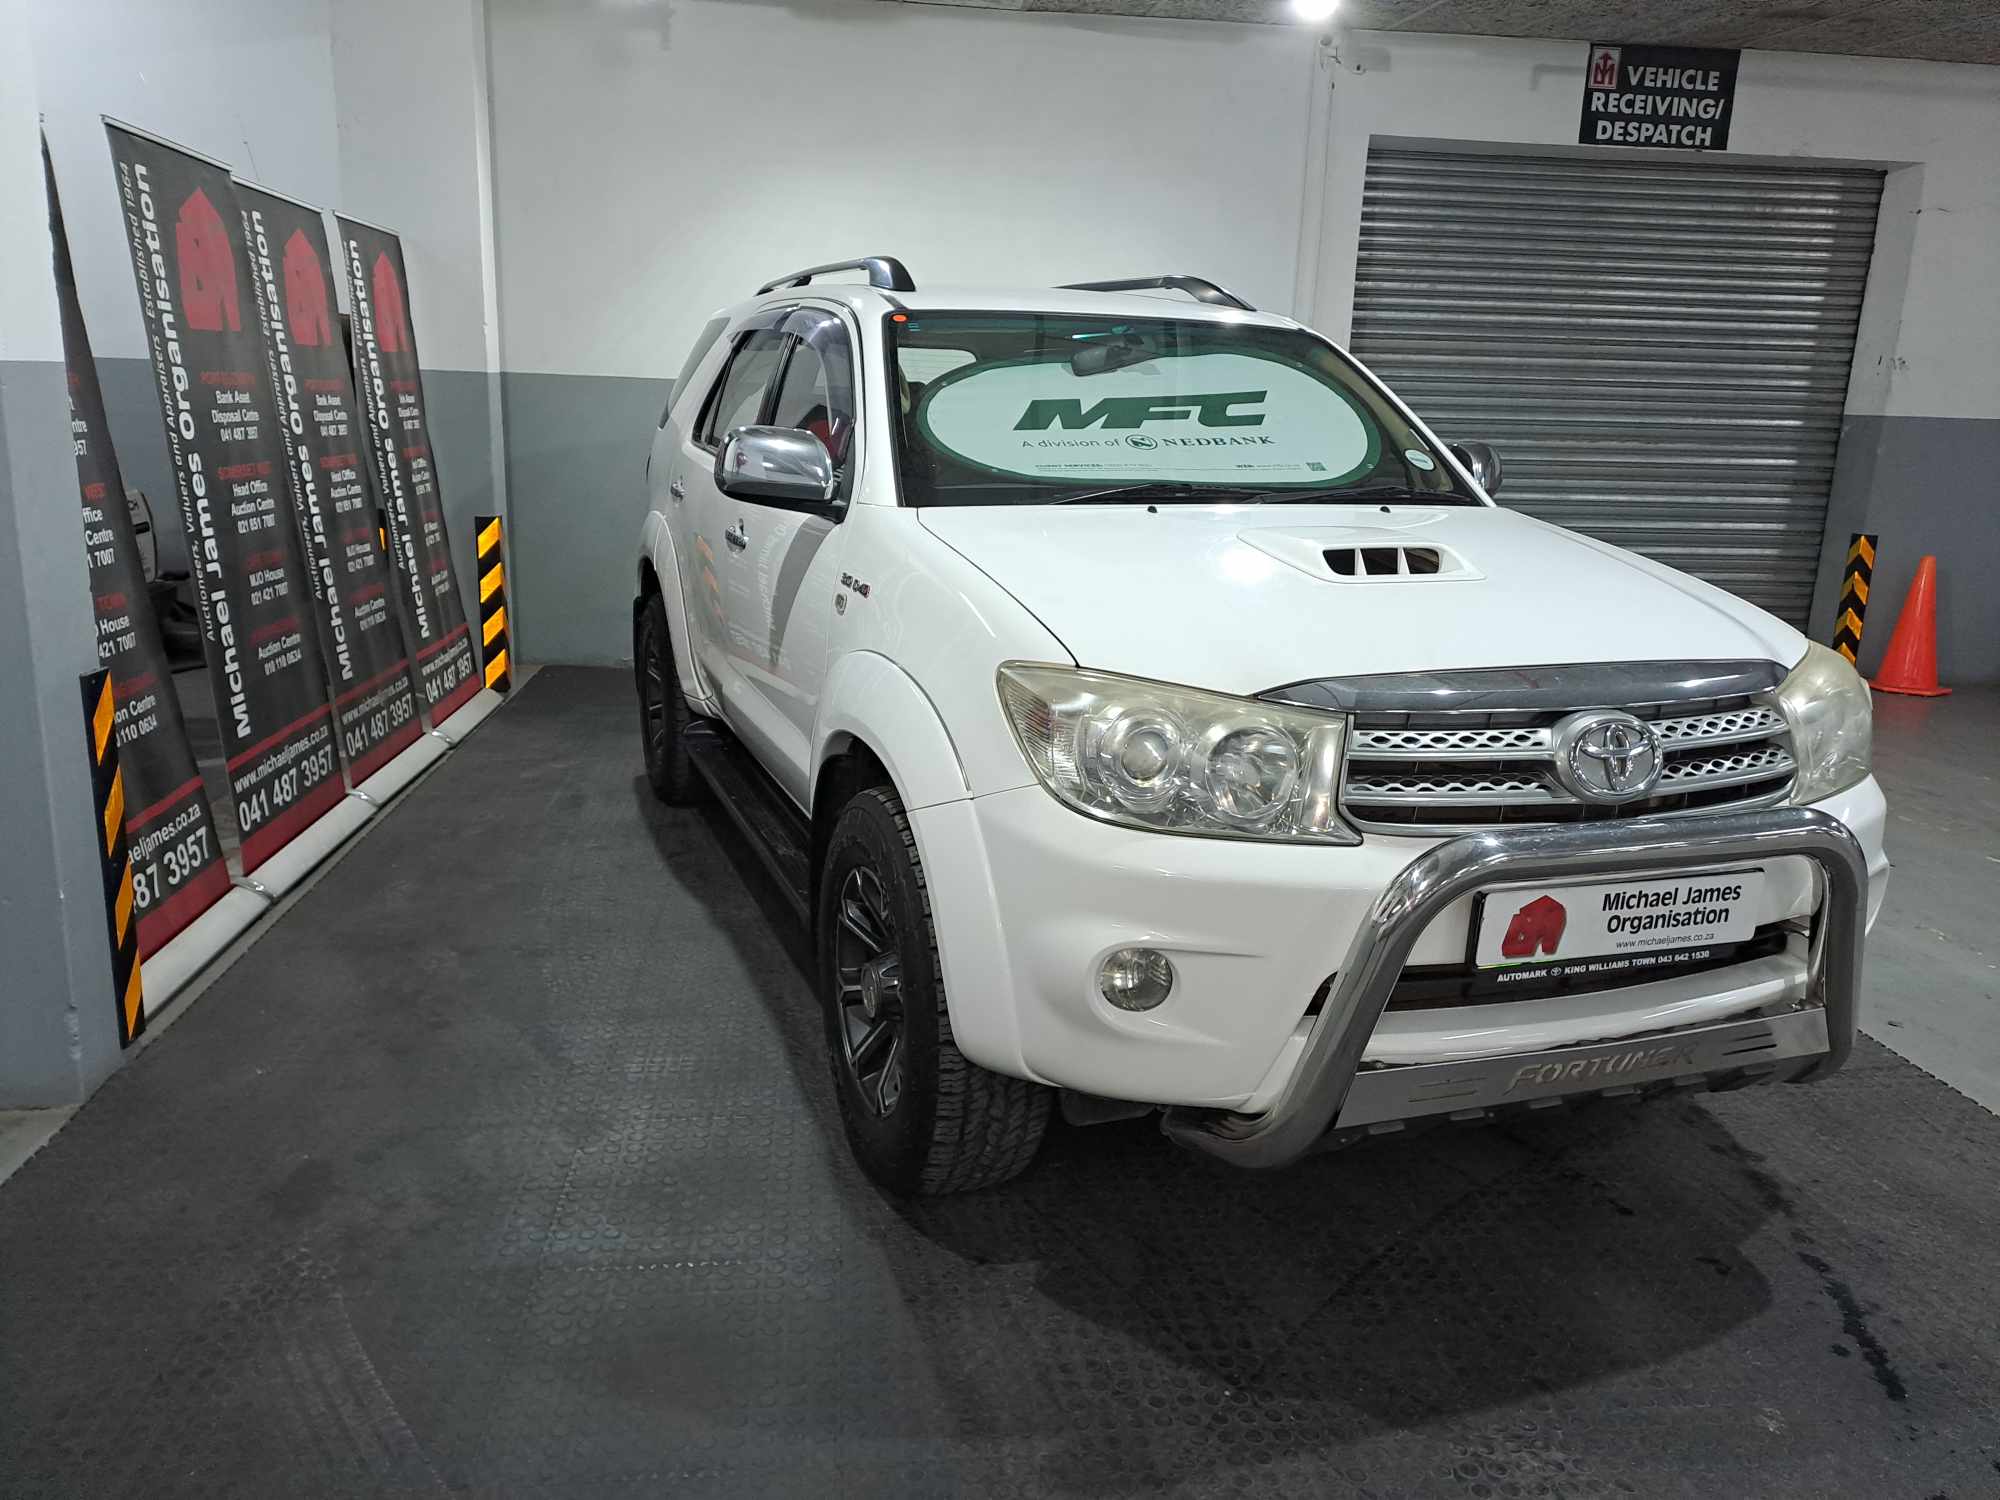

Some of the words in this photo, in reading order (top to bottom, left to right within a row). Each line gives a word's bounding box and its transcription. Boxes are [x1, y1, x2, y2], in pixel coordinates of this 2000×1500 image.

[1591, 91, 1725, 120] RECEIVING/
[1627, 65, 1720, 92] VEHICLE
[1595, 120, 1713, 146] DESPATCH
[120, 161, 137, 207] 1964
[127, 212, 156, 319] Established
[134, 163, 195, 440] Organisation
[251, 211, 303, 435] Organisation
[349, 240, 389, 429] Organisation
[152, 335, 177, 428] Appraisers
[1012, 390, 1268, 431] MFC
[169, 431, 183, 466] and
[281, 428, 294, 456] and
[1021, 439, 1035, 449] A
[1038, 437, 1101, 449] division
[1103, 437, 1123, 448] of
[1161, 434, 1278, 449] NEDBANK
[178, 471, 196, 533] Valuers
[231, 501, 256, 517] Auction
[289, 460, 304, 511] Valuers
[298, 445, 328, 549] James
[384, 438, 409, 527] James
[85, 528, 115, 546] Centre
[188, 452, 223, 579] James
[192, 540, 216, 642] Auctioneers,
[401, 533, 430, 639] Michael
[99, 614, 131, 636] House
[319, 558, 353, 681] Michael
[210, 590, 252, 740] Michael
[129, 694, 157, 716] Centre
[345, 721, 369, 757] 041
[370, 708, 389, 740] 487
[389, 692, 413, 727] 3957
[233, 724, 329, 794] www.michaeljames.co.za
[239, 788, 269, 832] 041
[272, 768, 298, 807] 487
[300, 743, 333, 787] 3957
[162, 826, 210, 886] 3957
[1602, 887, 1679, 911] Michael
[1682, 884, 1742, 905] James
[1606, 906, 1730, 934] Organisation
[1615, 933, 1715, 949] www.michaeljames.co.za
[1497, 969, 1548, 983] AUTOMARK
[1564, 964, 1587, 975] KING
[1588, 959, 1630, 972] WILLIAMS
[1631, 957, 1656, 967] TOWN
[1657, 955, 1673, 964] 043
